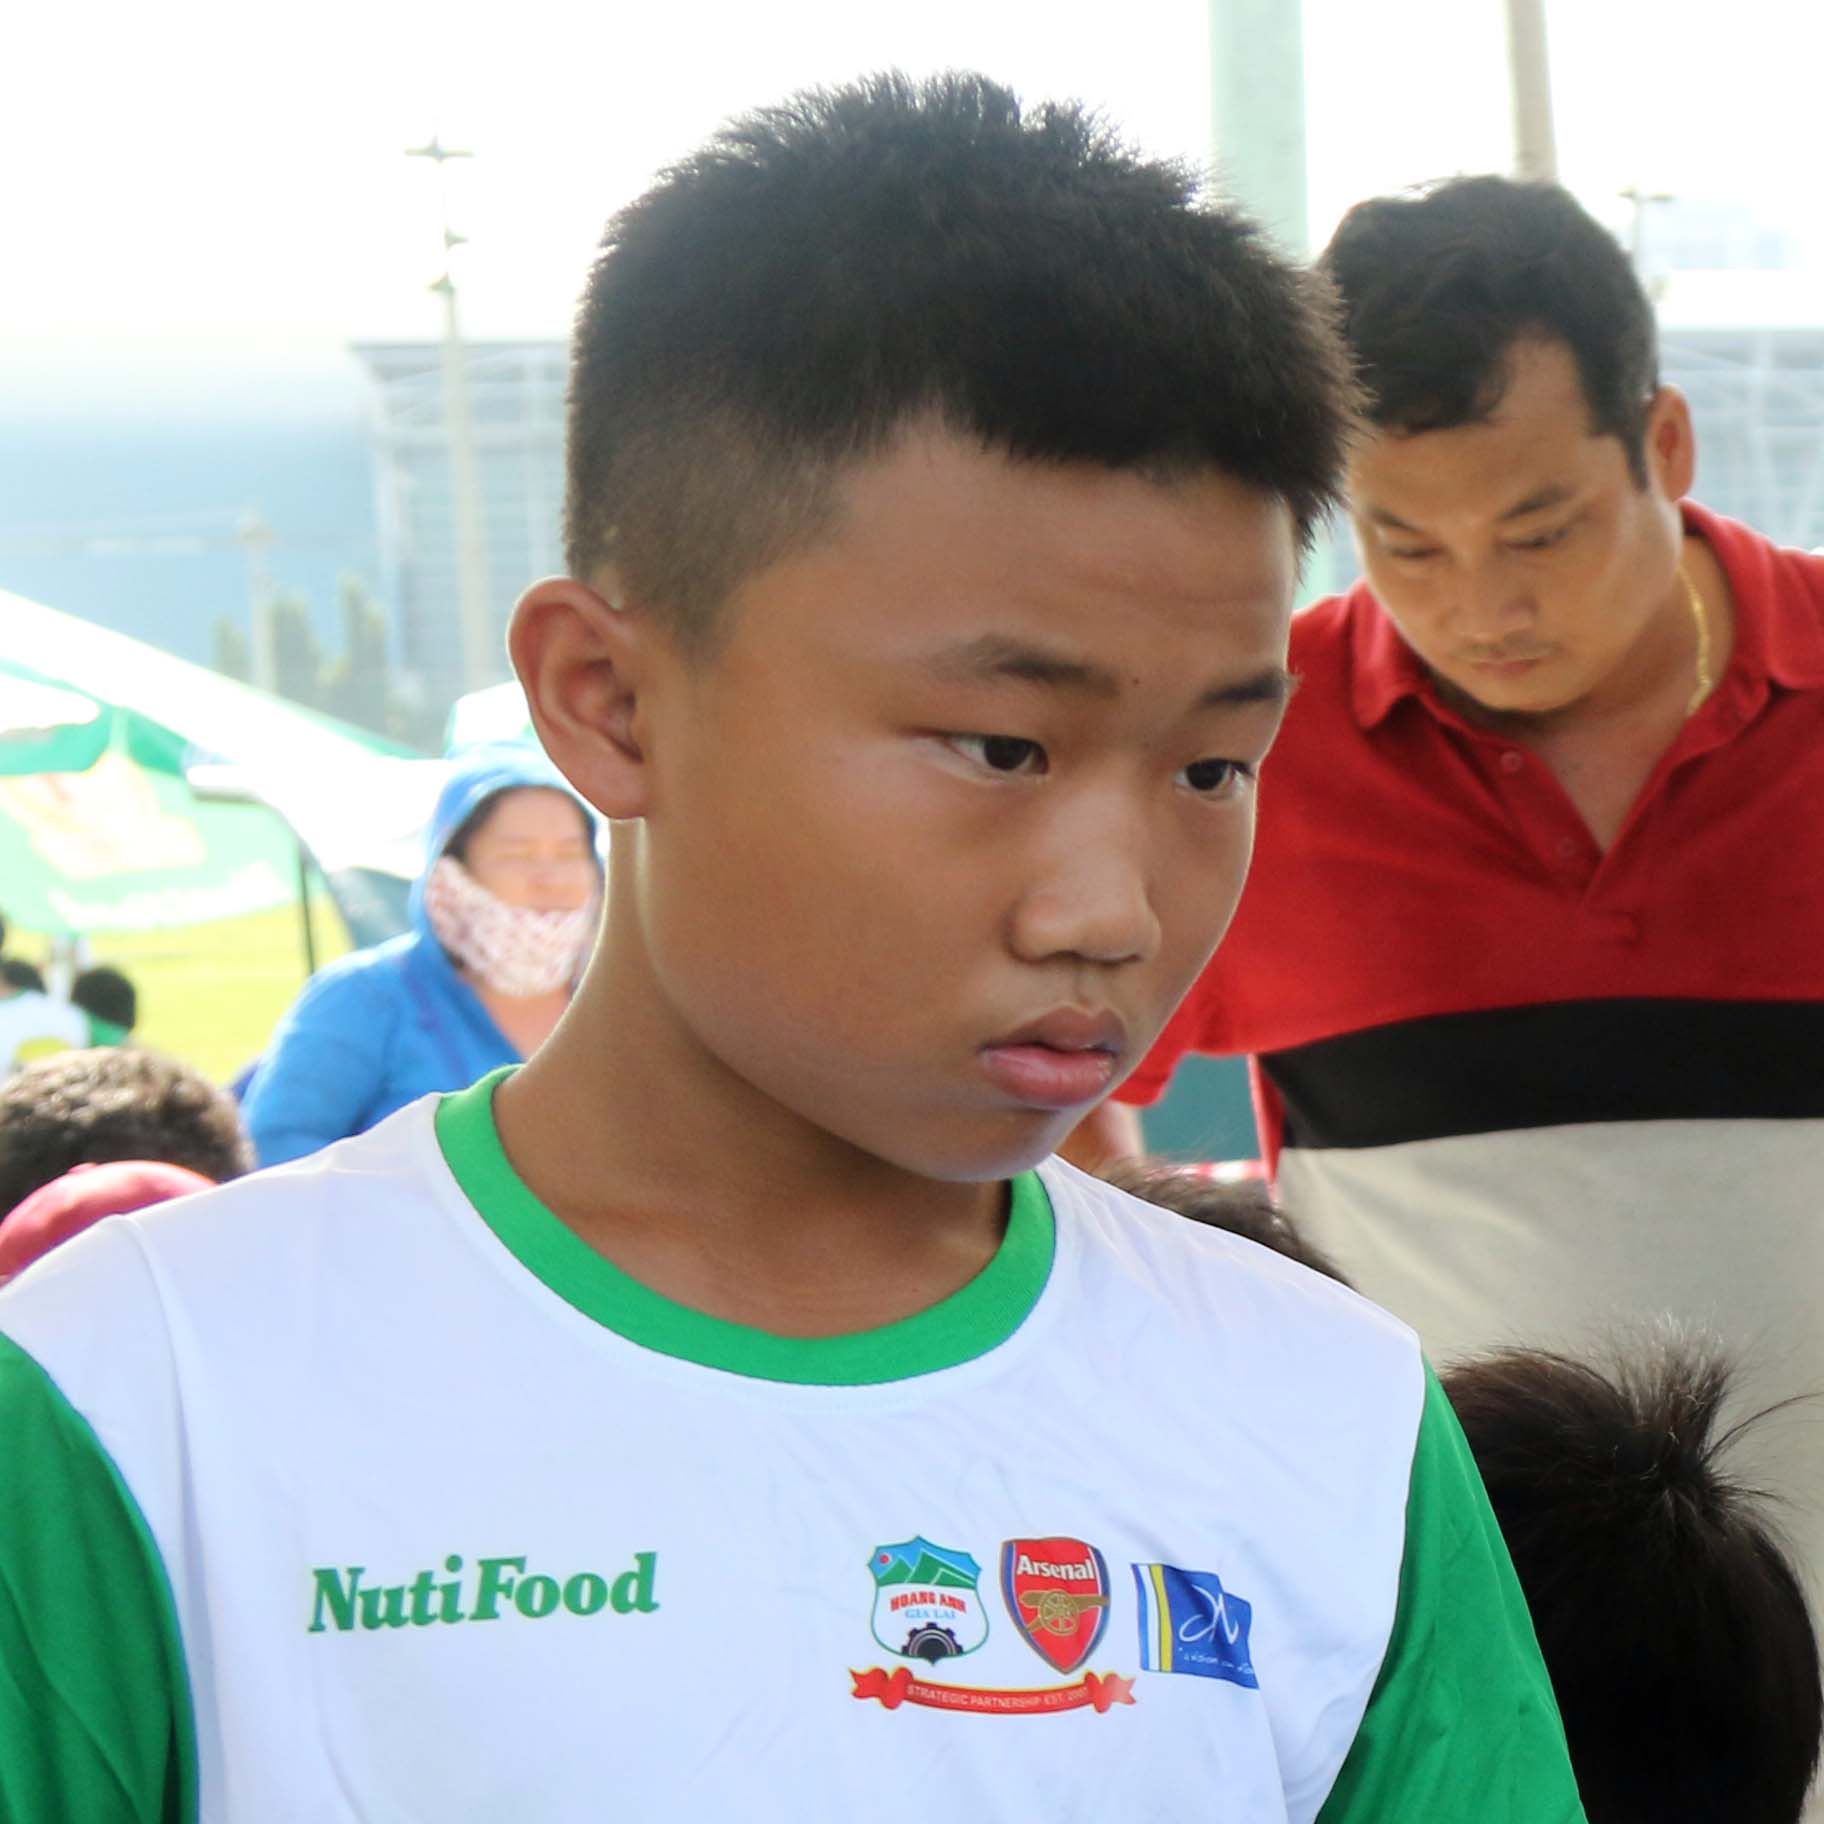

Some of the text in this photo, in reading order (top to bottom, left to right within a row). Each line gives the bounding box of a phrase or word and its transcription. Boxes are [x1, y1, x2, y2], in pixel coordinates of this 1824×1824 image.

[1017, 1554, 1095, 1580] Arsenal
[308, 1551, 659, 1634] NutiFood
[906, 1684, 968, 1706] STRATEGIC
